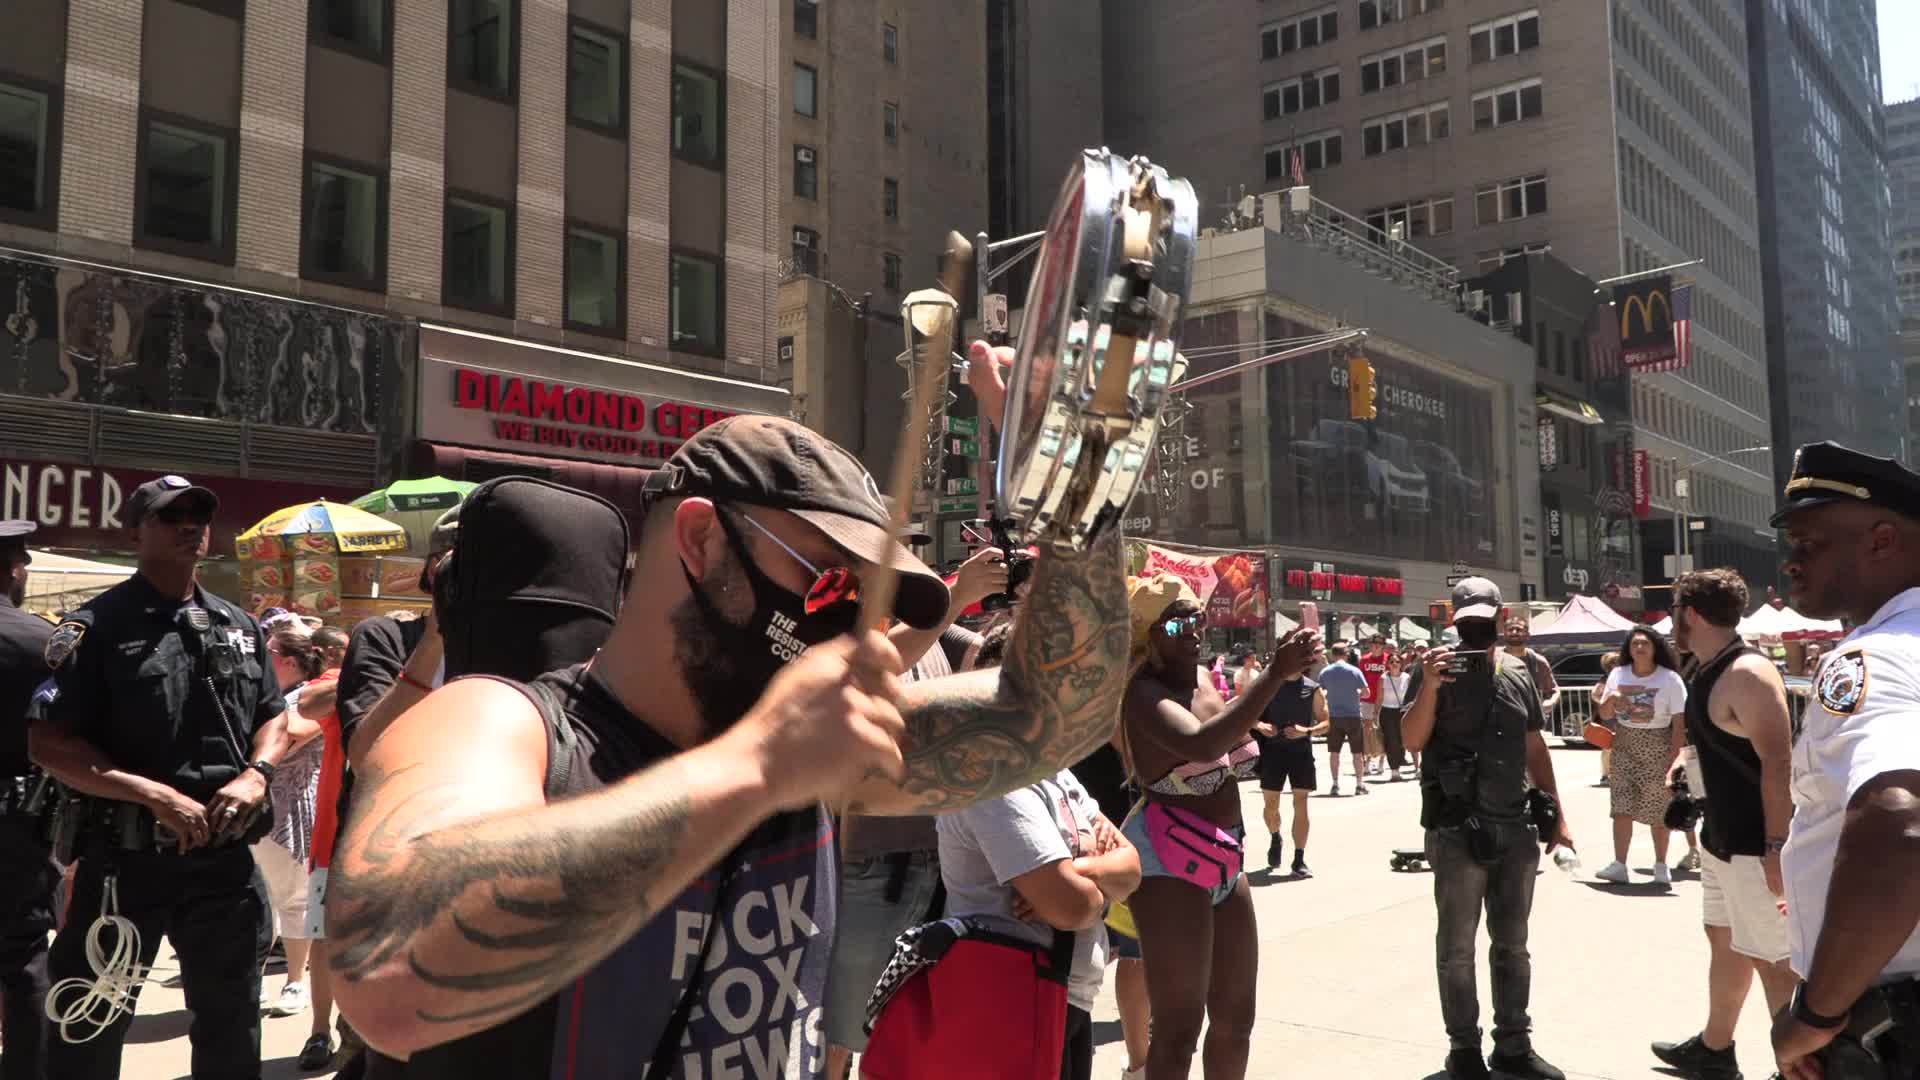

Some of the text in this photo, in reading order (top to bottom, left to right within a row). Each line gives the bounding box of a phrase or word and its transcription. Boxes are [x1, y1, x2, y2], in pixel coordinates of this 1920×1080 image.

[456, 367, 645, 433] DIAMOND
[1383, 384, 1446, 418] CHEROKEE
[494, 418, 533, 442] WE
[533, 424, 582, 449] BUY
[584, 431, 640, 457] GOLD
[4, 463, 123, 529] NGER
[1190, 467, 1225, 490] OF
[1634, 452, 1643, 505] McDonald's
[1118, 515, 1152, 534] eep
[765, 624, 808, 656] RESIST
[771, 610, 798, 634] THE
[1364, 662, 1386, 673] USA
[671, 947, 809, 1047] OX
[640, 1007, 827, 1080] EWS
